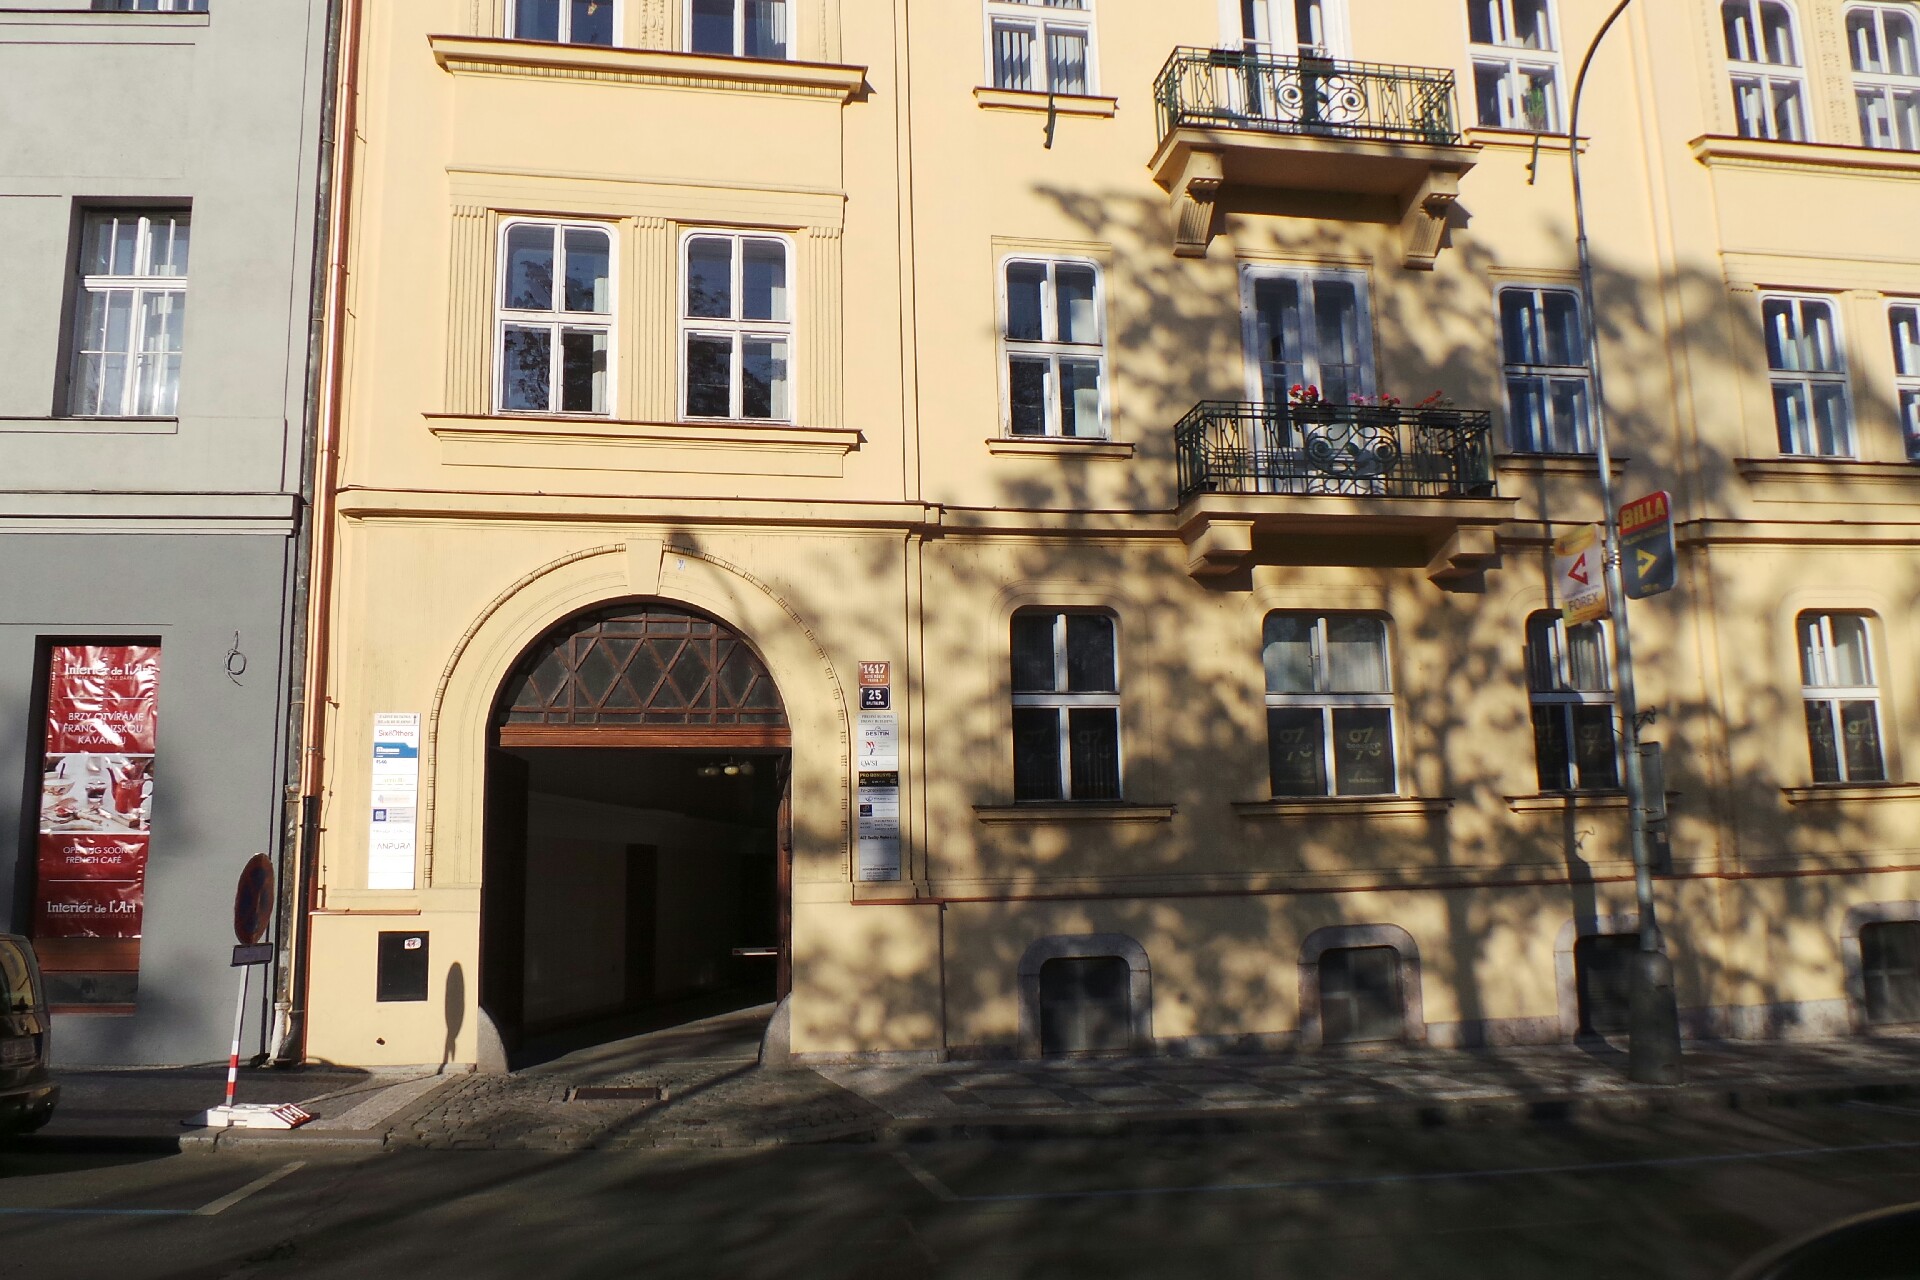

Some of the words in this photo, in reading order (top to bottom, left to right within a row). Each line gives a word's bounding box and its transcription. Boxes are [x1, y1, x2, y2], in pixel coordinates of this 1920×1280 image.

[1622, 497, 1666, 530] BILLA
[1568, 592, 1599, 612] FOREX
[111, 666, 123, 675] de
[863, 664, 886, 674] 1417
[868, 690, 882, 700] 25
[94, 711, 144, 720] OTVÍRÁME
[103, 846, 128, 854] SOON
[376, 842, 411, 850] ANPURA
[100, 855, 122, 864] CAFÉ
[47, 901, 93, 913] Interiér
[94, 904, 107, 913] de
[109, 899, 136, 913] l'Art
